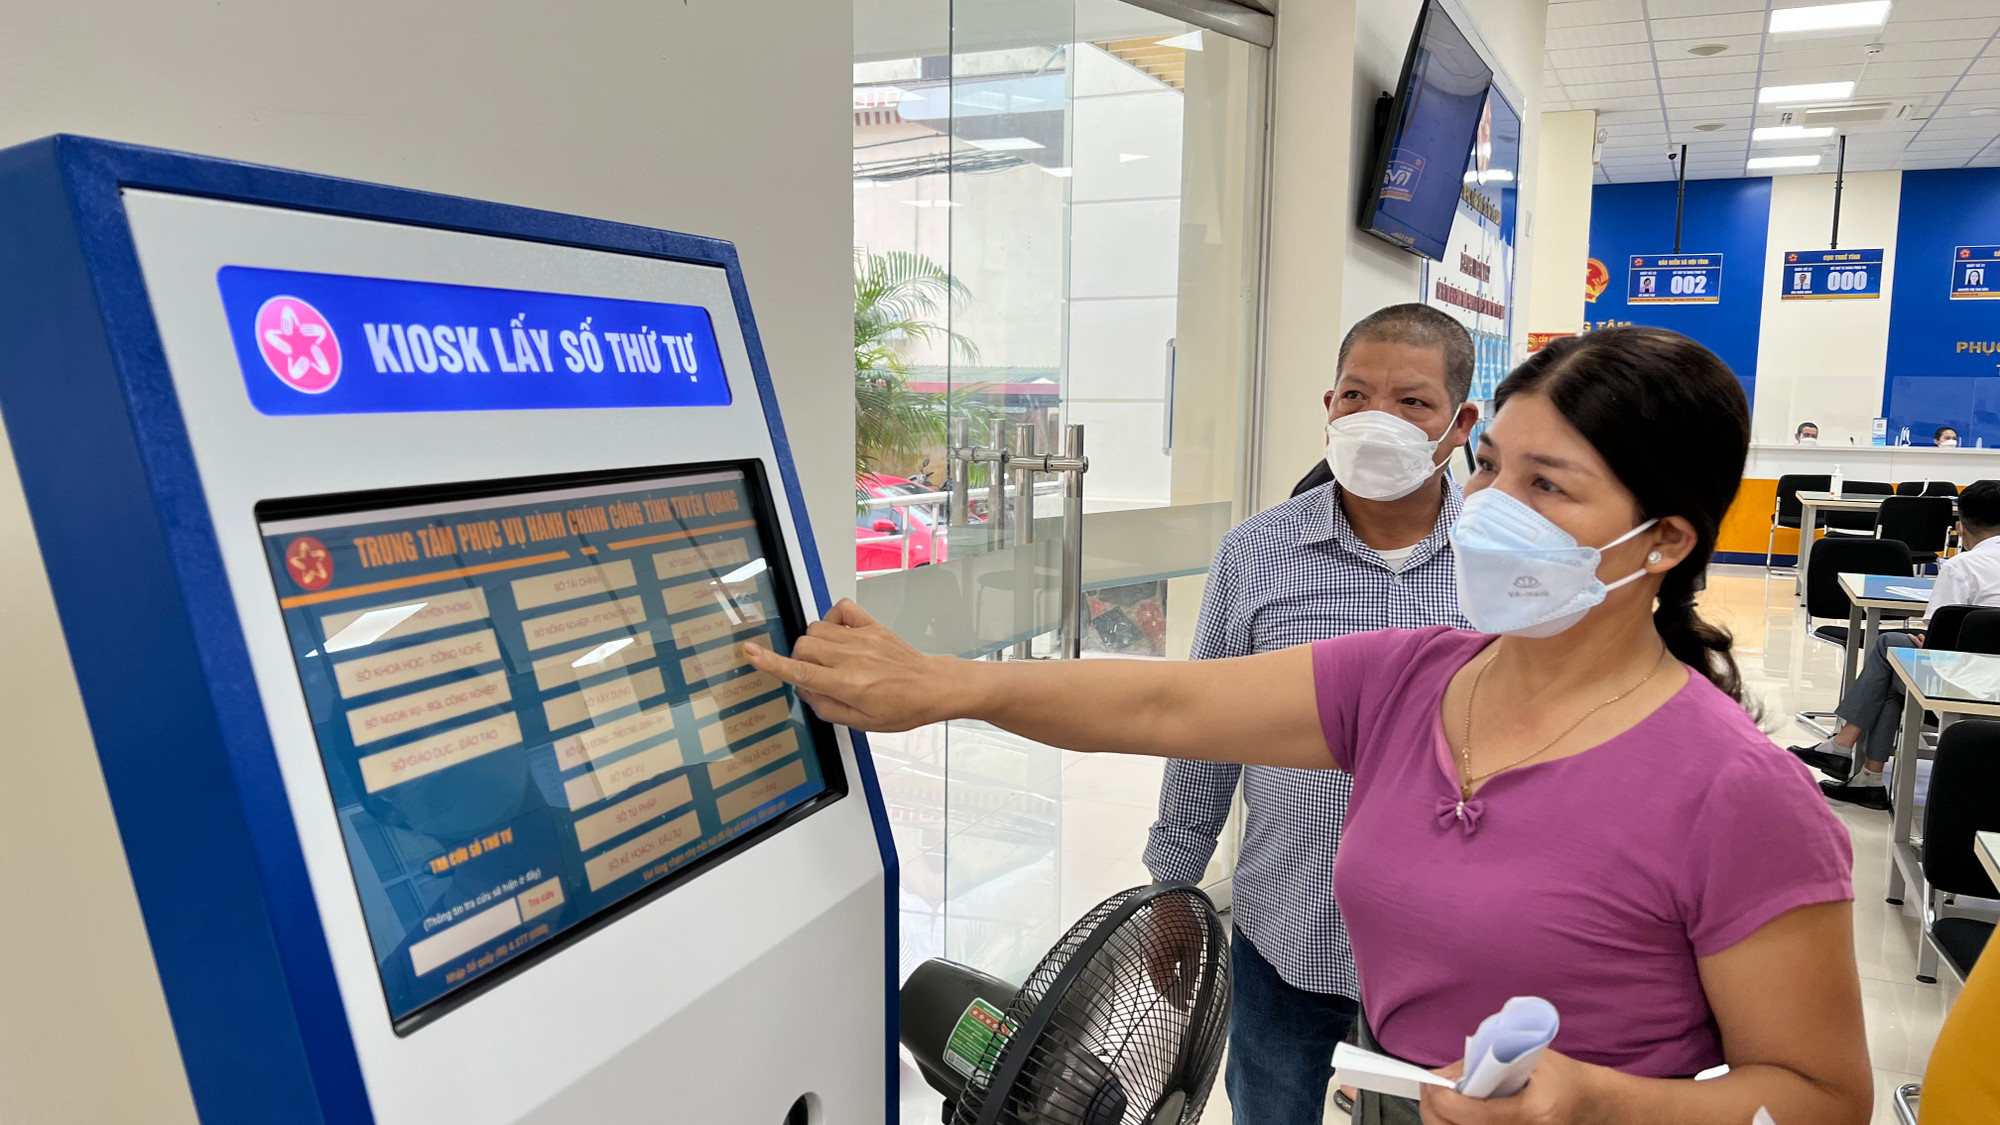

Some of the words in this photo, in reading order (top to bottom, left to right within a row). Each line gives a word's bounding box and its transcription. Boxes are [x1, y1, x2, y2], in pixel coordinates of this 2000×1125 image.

[1671, 275, 1707, 295] 002
[1827, 271, 1867, 291] 000
[363, 323, 490, 374] KIOSK
[489, 313, 554, 372] LẤY
[561, 317, 604, 374] SỐ
[604, 325, 663, 374] THỨ
[662, 332, 699, 383] TỰ
[353, 532, 419, 568] TRUNG
[417, 523, 457, 559] TÂM
[457, 518, 503, 554] PHỤC
[502, 516, 527, 549] VỤ
[525, 509, 567, 542] HÀNH
[566, 504, 609, 536] CHÍNH
[608, 500, 645, 530] CÔNG
[642, 494, 675, 524] TỈNH
[670, 491, 705, 520] TUYÊN
[704, 489, 739, 517] QUANG
[356, 668, 372, 682] SỞ
[616, 810, 628, 824] SỞ
[607, 858, 620, 872] SỞ
[423, 911, 455, 933] (Thông
[452, 904, 465, 916] tin
[463, 899, 476, 911] tra
[502, 879, 518, 892] hiện
